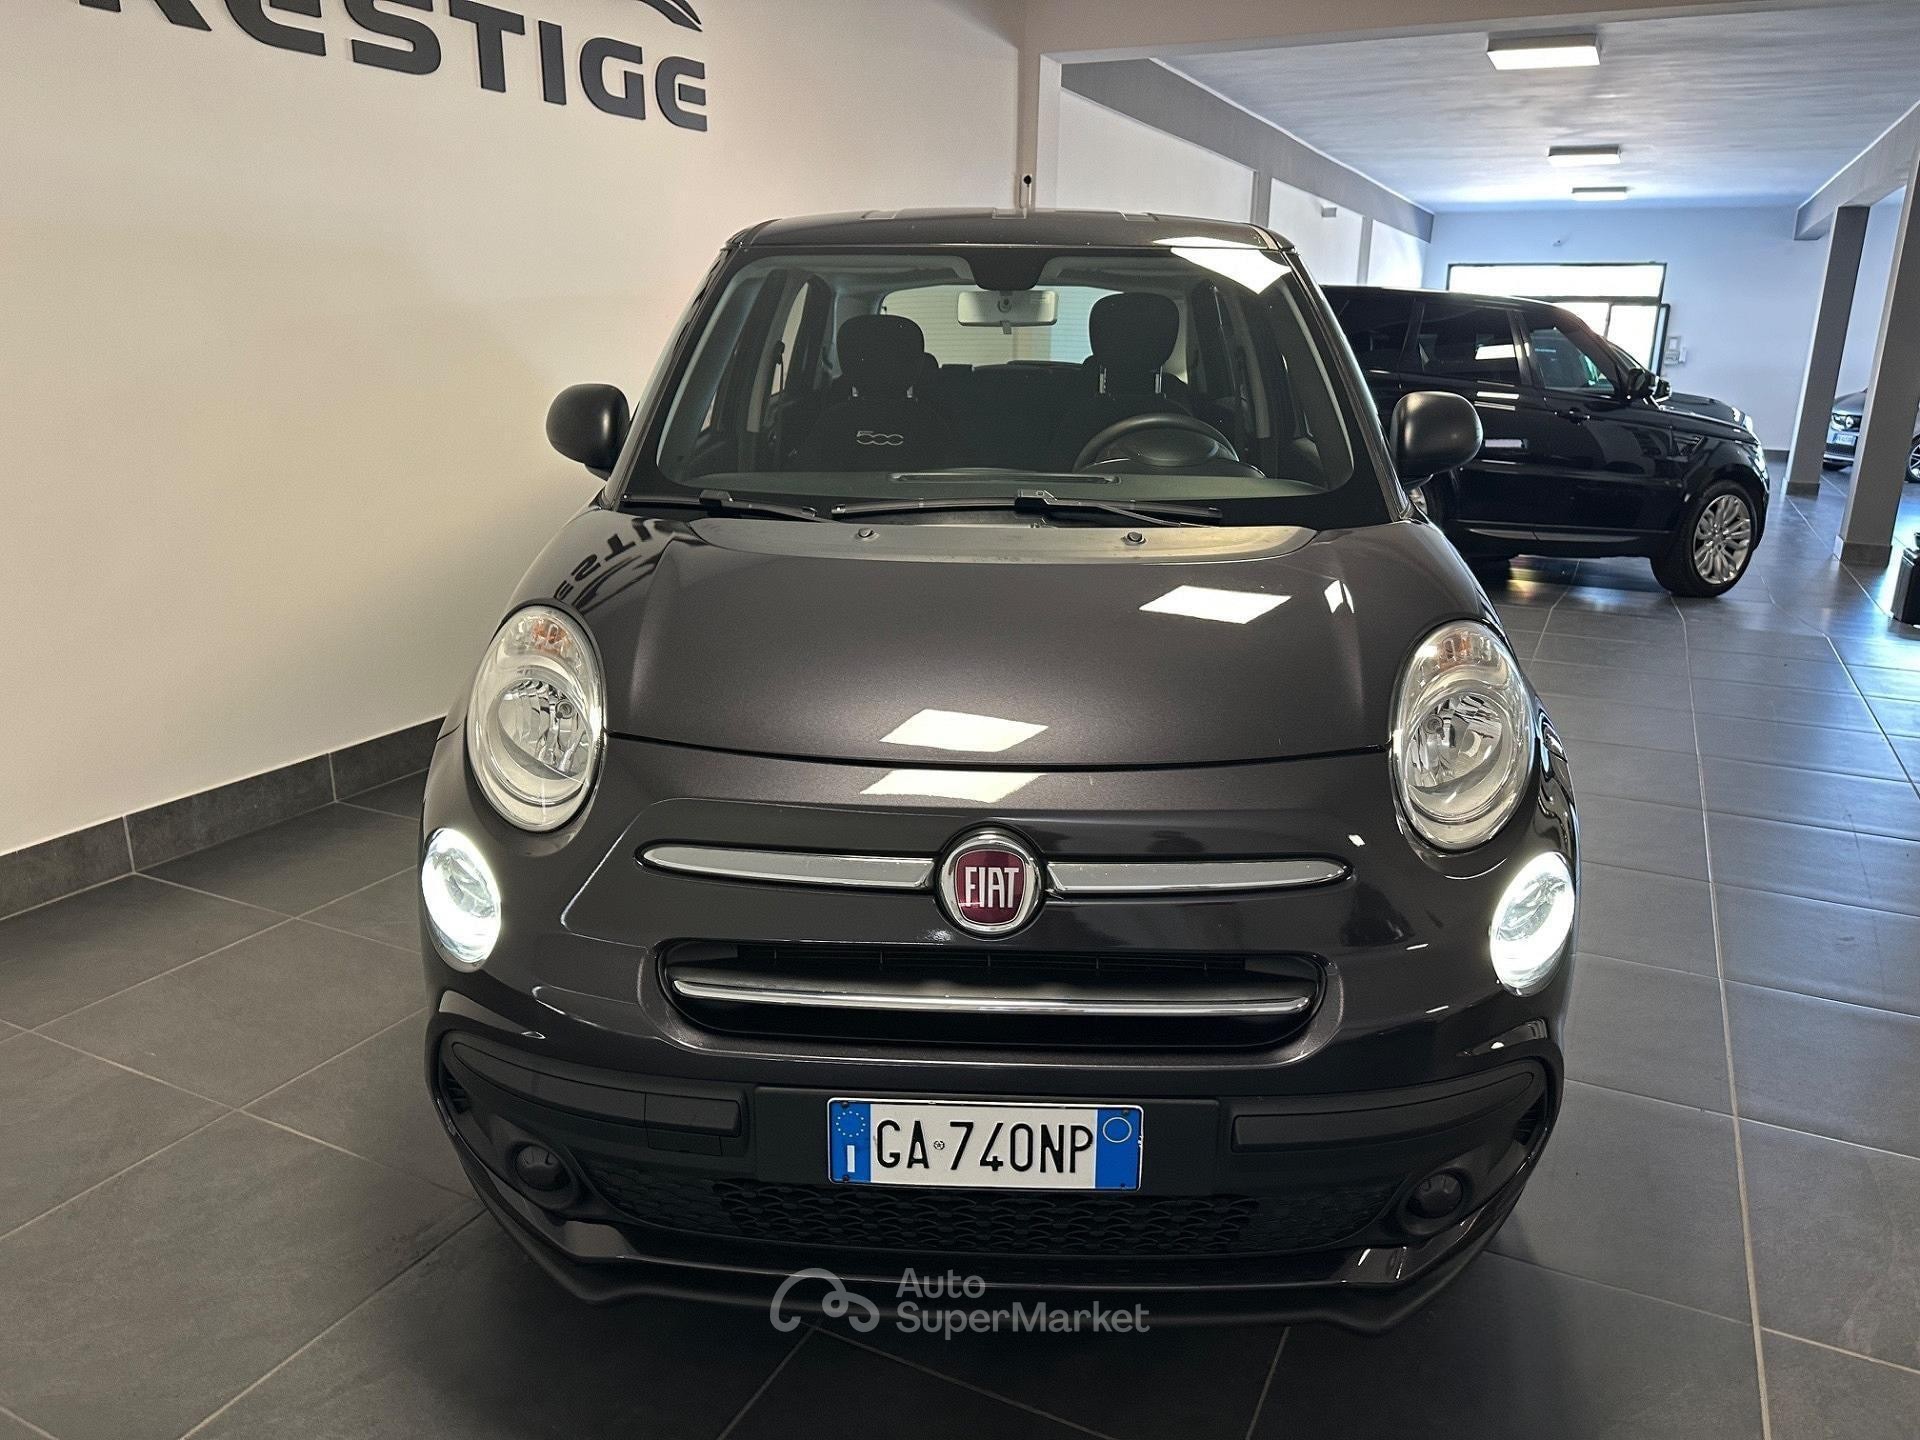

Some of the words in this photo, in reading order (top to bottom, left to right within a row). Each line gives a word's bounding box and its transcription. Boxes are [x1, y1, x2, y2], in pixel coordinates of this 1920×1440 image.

[965, 866, 1020, 909] FIAT
[876, 1119, 931, 1169] GA
[949, 1121, 1095, 1174] 740NP
